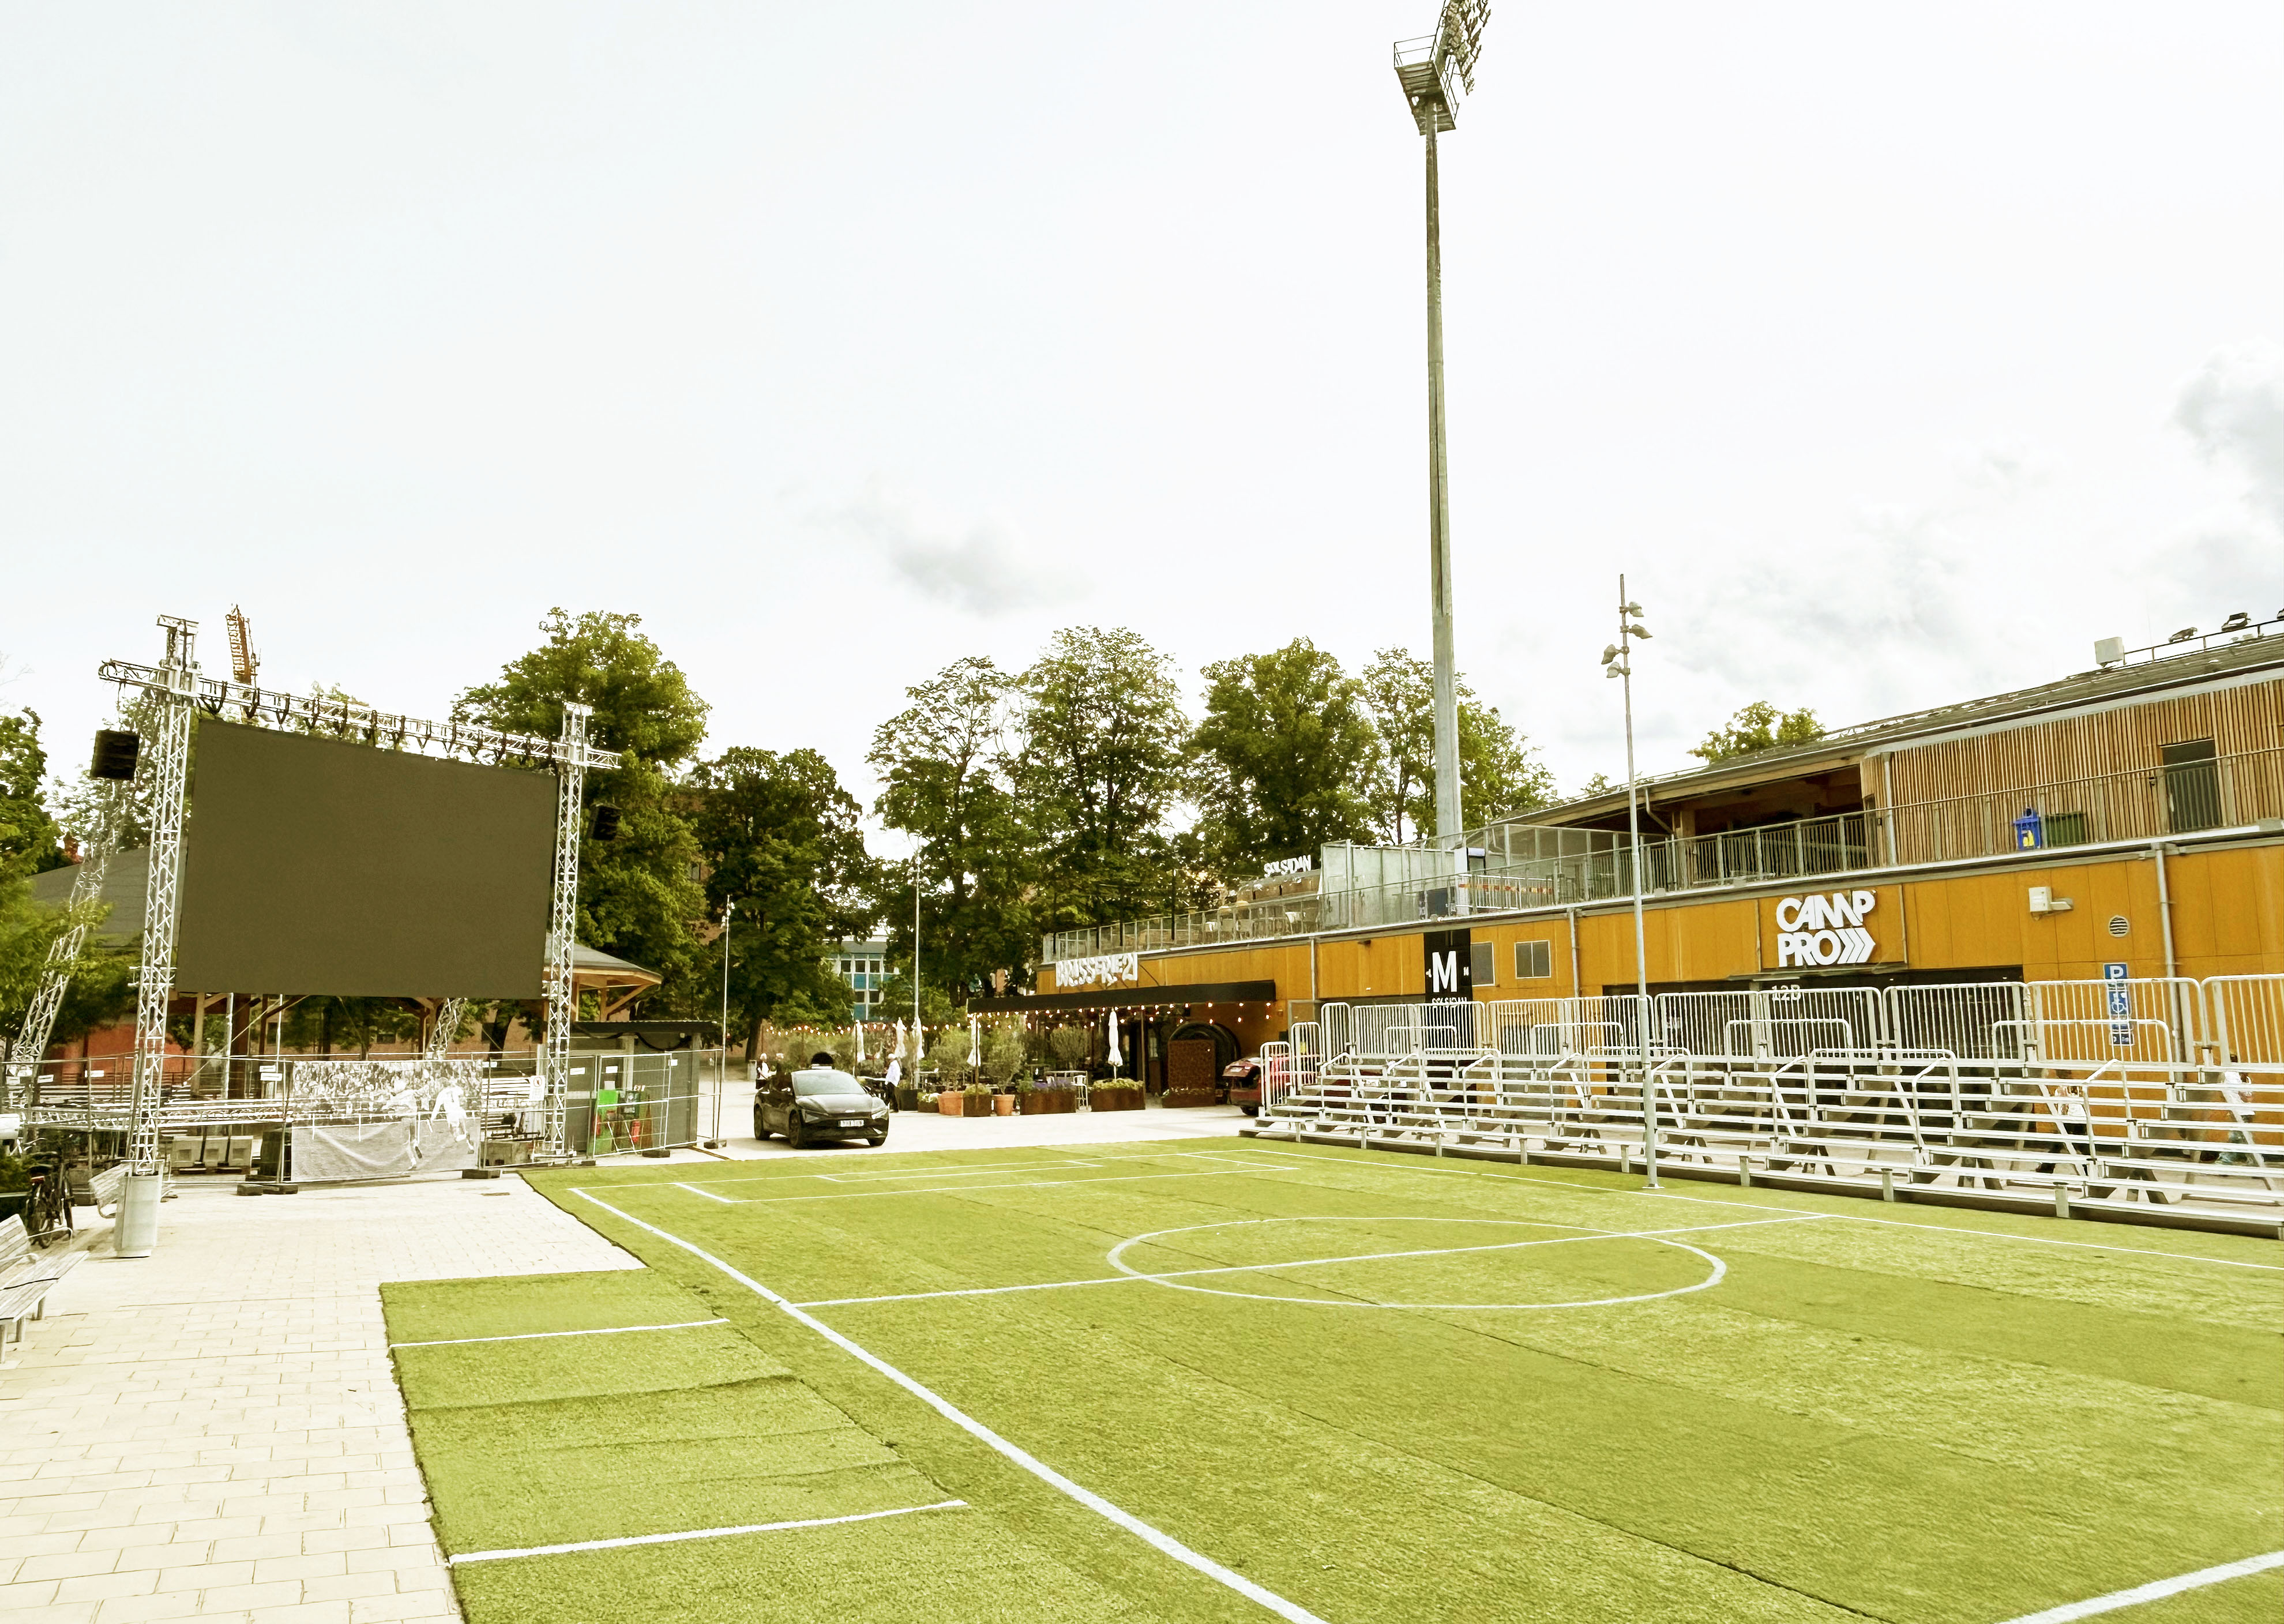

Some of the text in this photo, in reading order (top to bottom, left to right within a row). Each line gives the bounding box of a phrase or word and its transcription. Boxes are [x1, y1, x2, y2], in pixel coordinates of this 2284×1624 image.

[1776, 890, 1876, 932] CAMP
[1777, 930, 1841, 968] PRO
[1432, 950, 1457, 993] M
[2110, 965, 2124, 979] P
